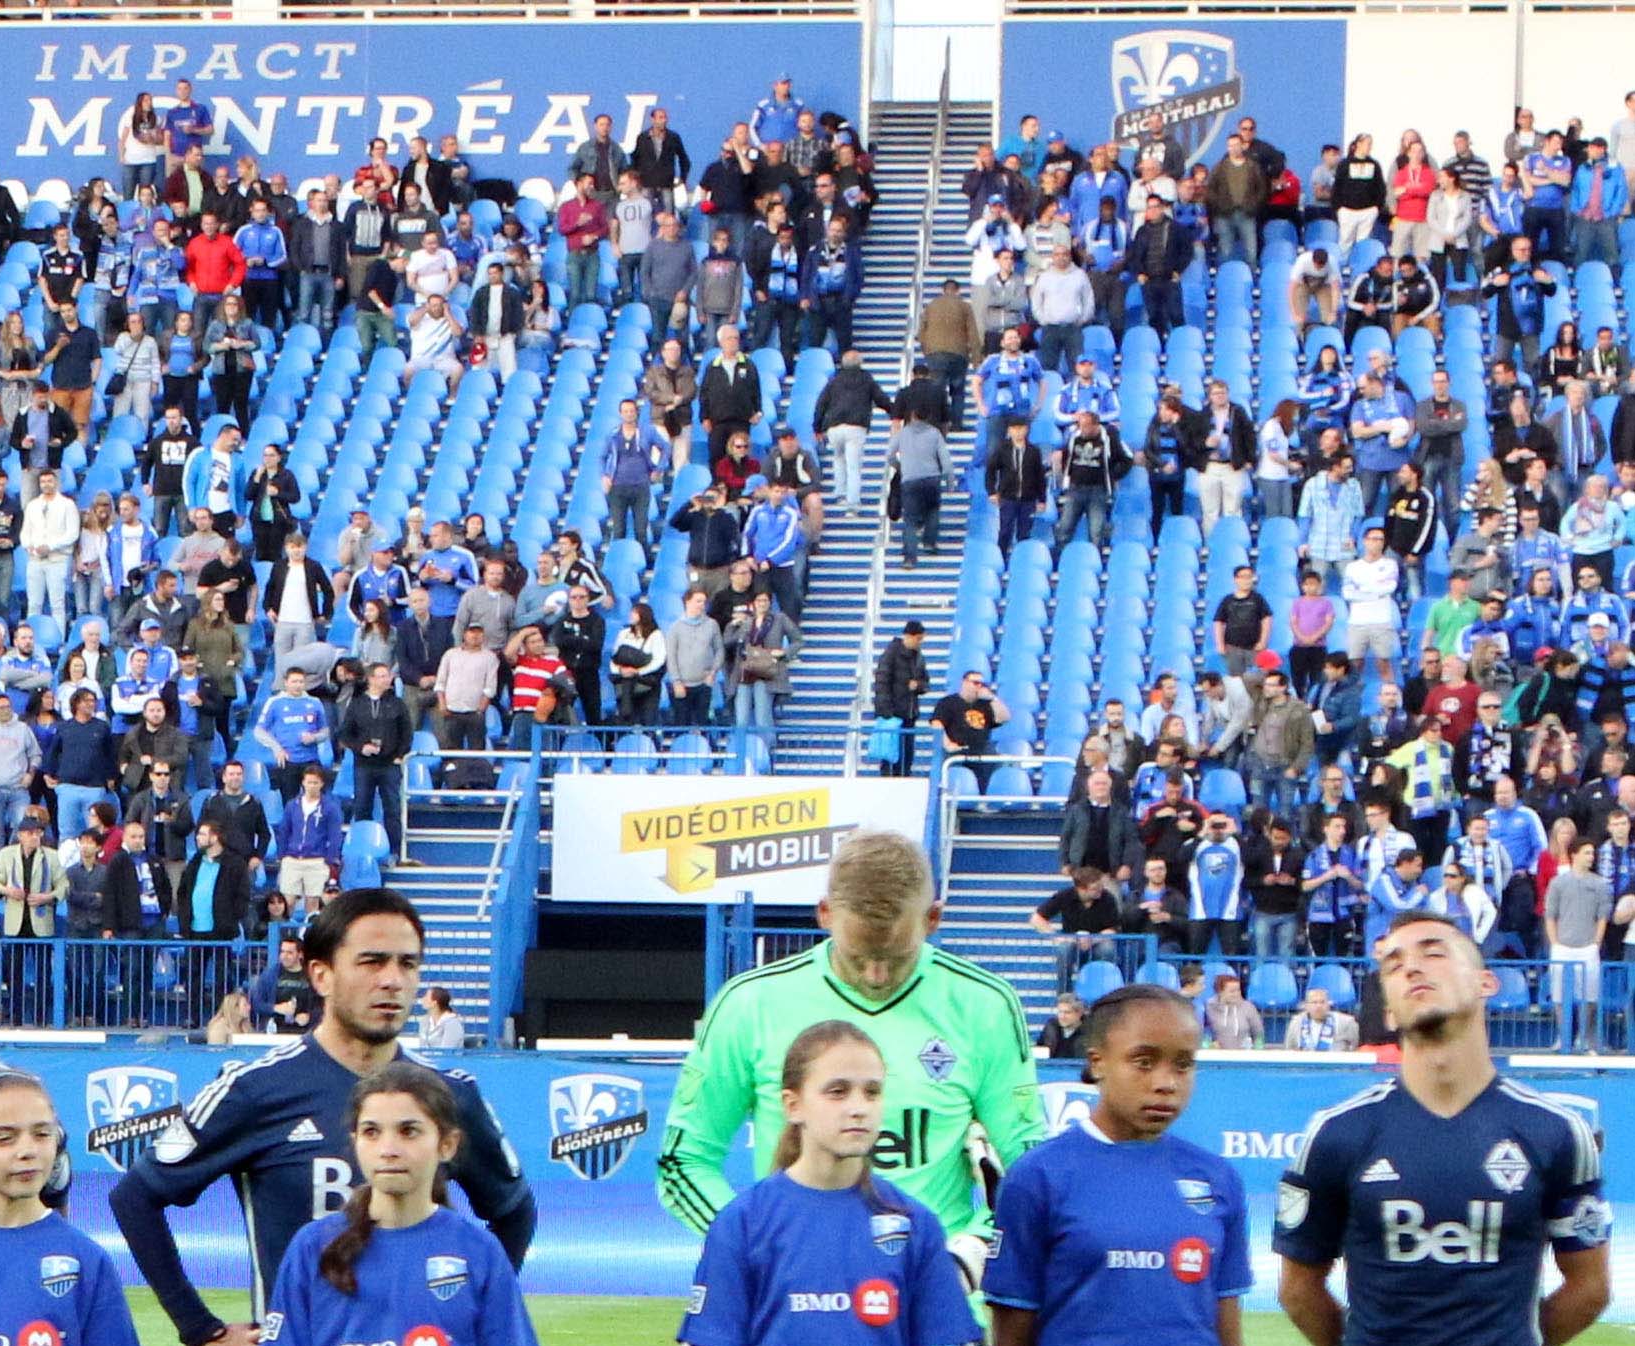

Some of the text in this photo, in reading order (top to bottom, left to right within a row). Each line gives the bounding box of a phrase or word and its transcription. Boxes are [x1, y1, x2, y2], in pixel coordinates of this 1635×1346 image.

[34, 42, 358, 82] IMPACT
[632, 797, 818, 842] VIDÉOTRON
[869, 1108, 931, 1169] ell
[1382, 1200, 1504, 1264] Bell
[1106, 1250, 1165, 1269] BMO
[787, 1293, 852, 1312] BMO
